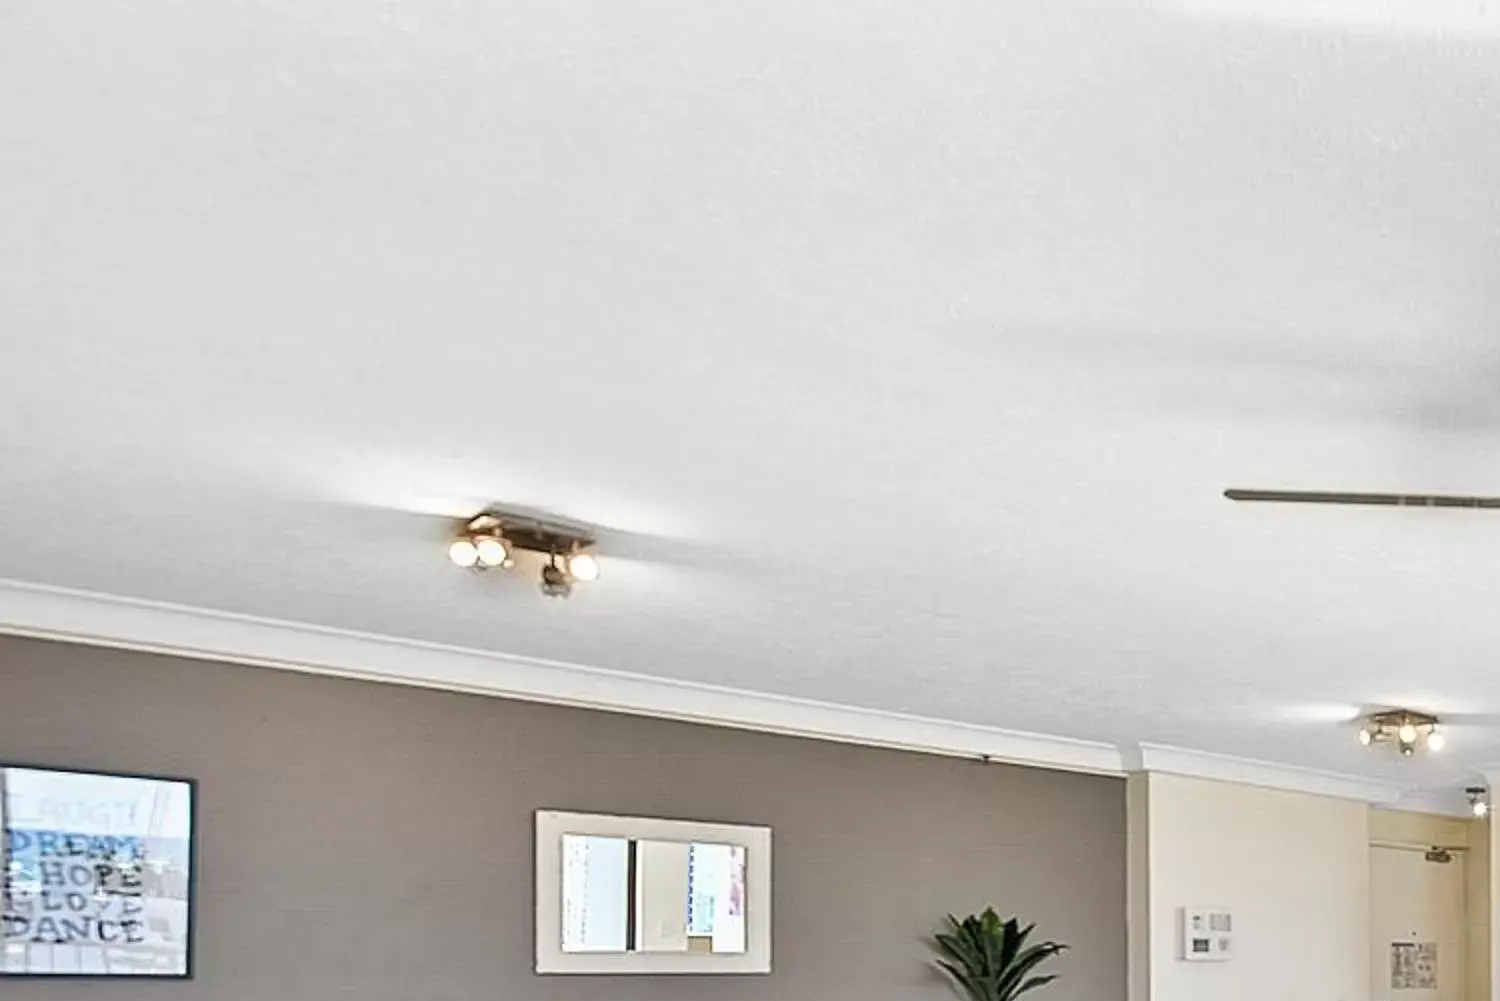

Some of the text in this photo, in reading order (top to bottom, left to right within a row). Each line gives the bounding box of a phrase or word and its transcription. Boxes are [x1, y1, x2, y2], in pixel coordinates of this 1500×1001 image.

[40, 860, 143, 888] HOPE
[41, 890, 143, 915] LOVE
[1, 914, 145, 944] DANCE
